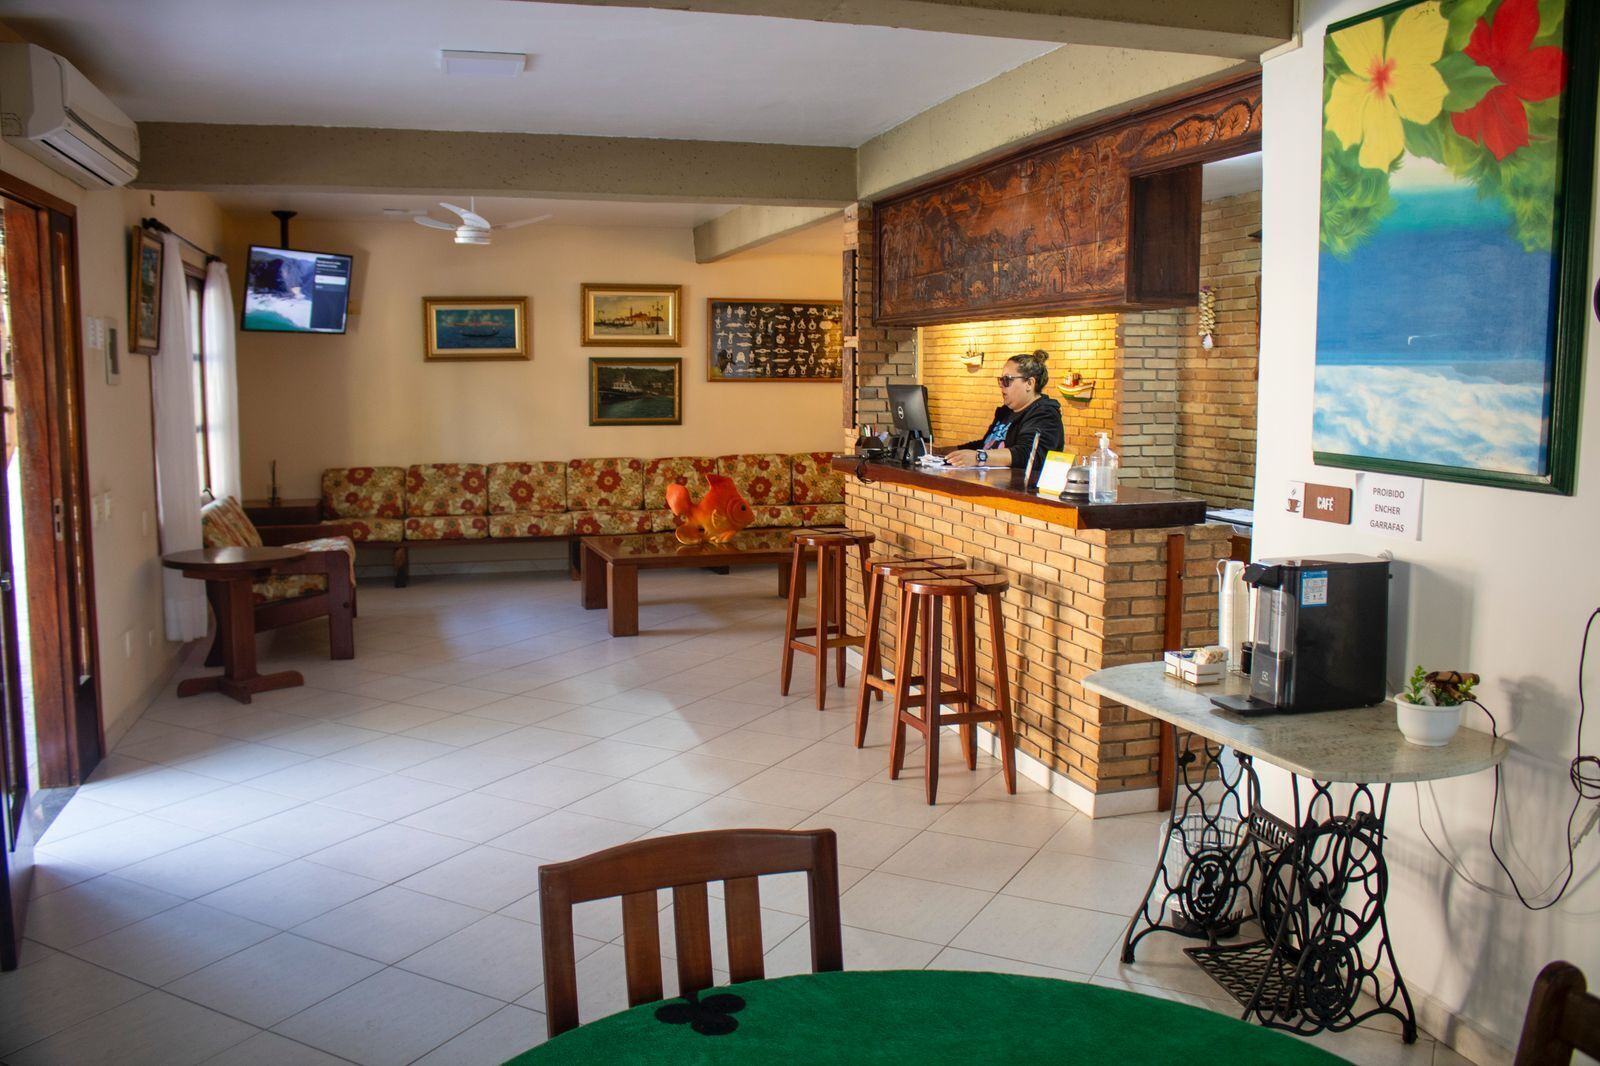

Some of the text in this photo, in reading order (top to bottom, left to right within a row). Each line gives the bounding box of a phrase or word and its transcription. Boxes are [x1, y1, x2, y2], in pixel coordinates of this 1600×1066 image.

[1373, 488, 1404, 499] PROIBIDO
[1317, 497, 1334, 511] CAFÉ
[1375, 504, 1400, 515] ENCHER
[1370, 520, 1404, 532] GARRAFAS
